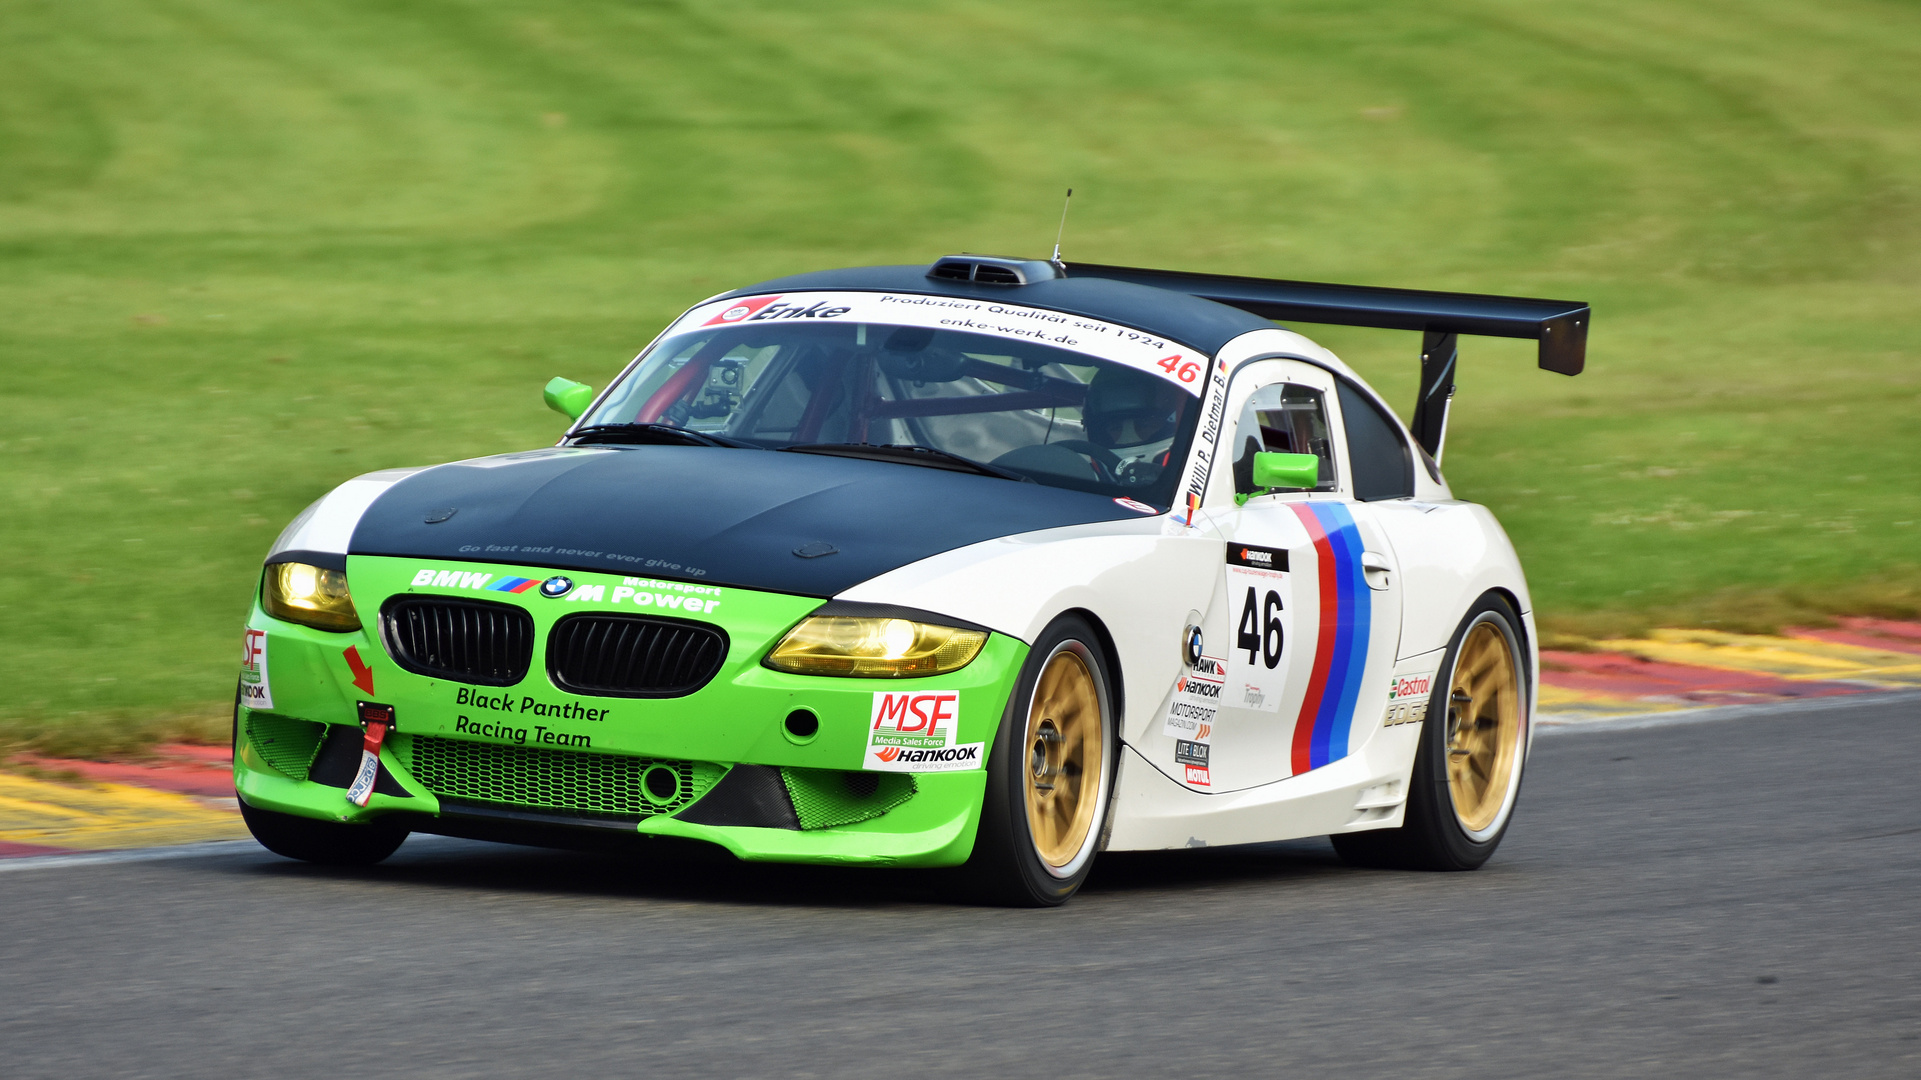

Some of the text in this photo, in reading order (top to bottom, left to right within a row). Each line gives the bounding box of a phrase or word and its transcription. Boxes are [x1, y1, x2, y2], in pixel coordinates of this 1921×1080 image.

[748, 301, 852, 321] Enke
[880, 295, 1165, 349] Produziert Qualität seit 1924
[940, 318, 1078, 346] enke-werk.de
[1156, 354, 1201, 383] 46
[1189, 375, 1226, 497] Willi P. Dietmar B.
[485, 544, 518, 552] fast
[555, 548, 603, 558] never
[606, 553, 644, 563] ever
[645, 559, 681, 570] give
[685, 566, 707, 577] up
[410, 569, 494, 590] BMW
[623, 577, 722, 596] Motorsport
[565, 584, 721, 614] M Power
[1237, 586, 1284, 670] 46
[1193, 659, 1216, 675] HAWK
[1244, 688, 1266, 708] Trophy
[1398, 675, 1431, 697] Castrol
[456, 687, 610, 722] Black Panther
[873, 694, 956, 736] MSF
[1170, 701, 1217, 722] MOTORSPORT
[455, 715, 591, 748] Racing Team
[875, 736, 944, 746] Media Sales Force
[912, 760, 977, 770] driving emotion
[1187, 768, 1210, 784] MOTUL
